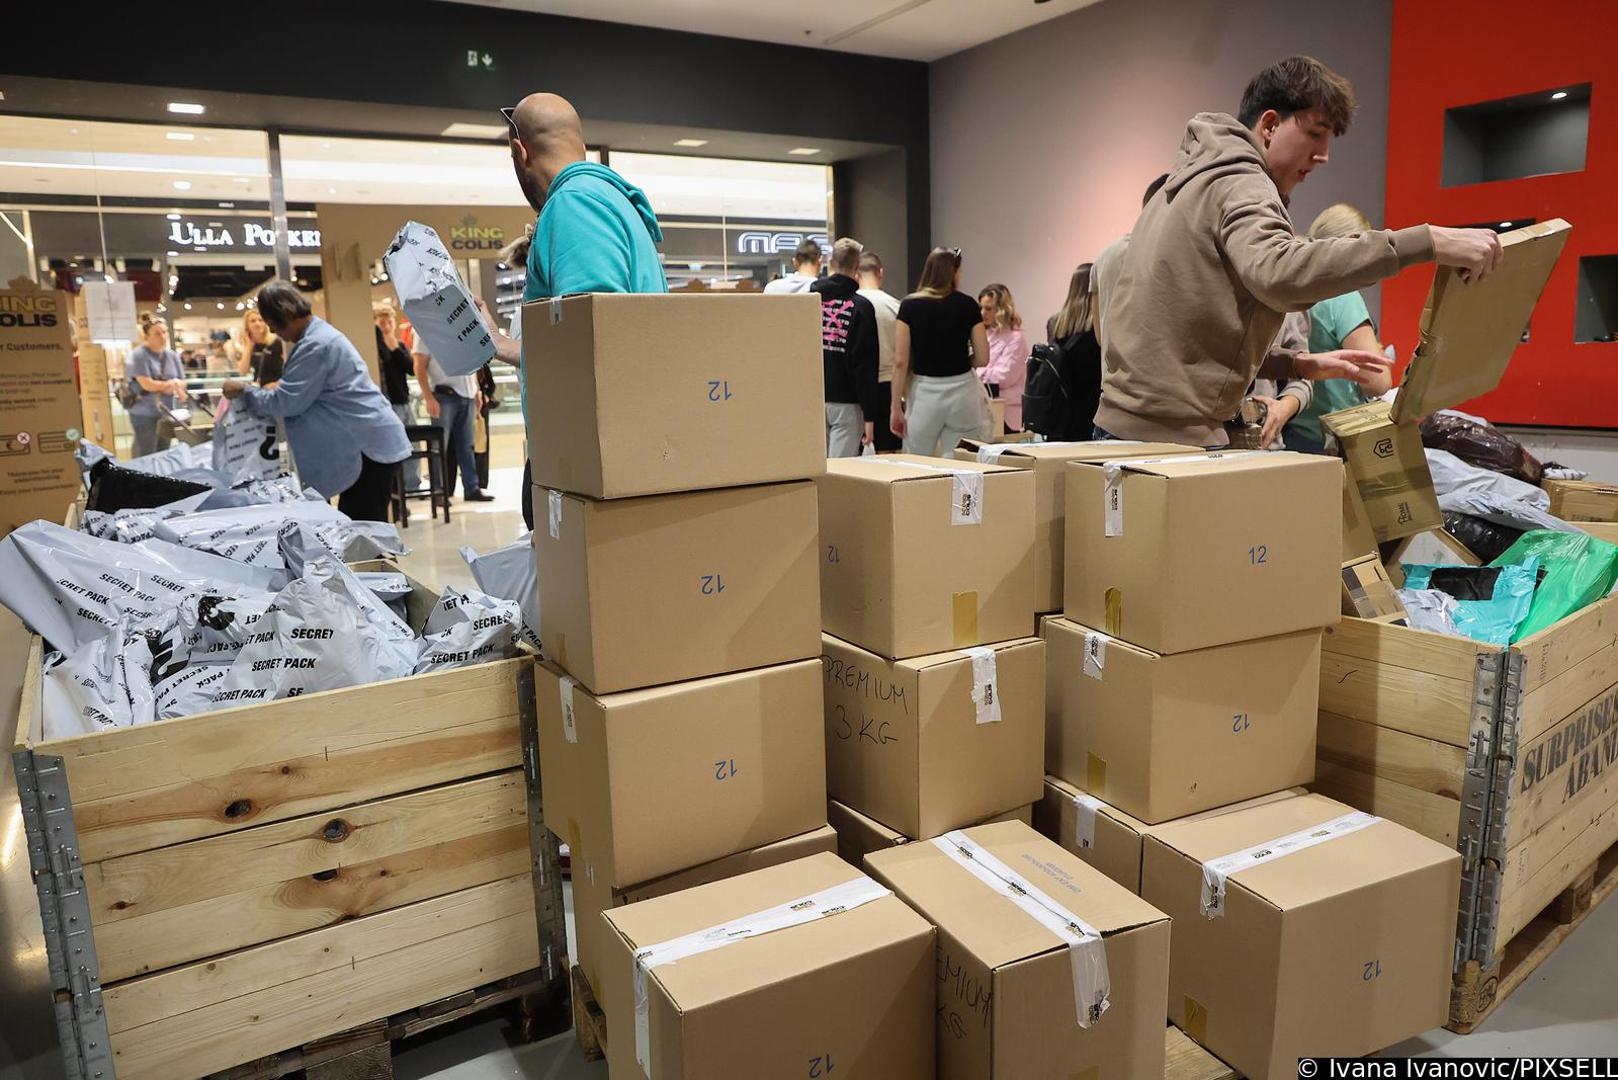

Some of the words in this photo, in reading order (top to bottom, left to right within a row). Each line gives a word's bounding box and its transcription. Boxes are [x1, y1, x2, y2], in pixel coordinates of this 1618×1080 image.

[168, 222, 234, 245] ULLA
[244, 223, 321, 247] POKE
[451, 227, 504, 239] KING
[452, 239, 504, 250] COLIS
[0, 296, 57, 313] ING
[0, 313, 58, 327] OLIS
[708, 381, 732, 401] 12
[1249, 545, 1267, 565] 12
[150, 574, 186, 593] SECRET
[701, 574, 725, 594] 12
[85, 590, 110, 605] PACK
[255, 631, 275, 644] PACK
[290, 628, 334, 640] SECRET
[431, 651, 470, 664] SECRET
[472, 643, 495, 658] PACK
[252, 658, 282, 671] SECRET
[284, 657, 317, 669] PACK
[240, 688, 267, 699] PACK
[821, 655, 908, 715] PREMIUM
[834, 704, 852, 740] 3
[859, 712, 899, 745] KG
[1233, 713, 1250, 732] 12
[715, 759, 738, 780] 12
[1363, 959, 1381, 981] 12
[809, 1054, 834, 1079] 12
